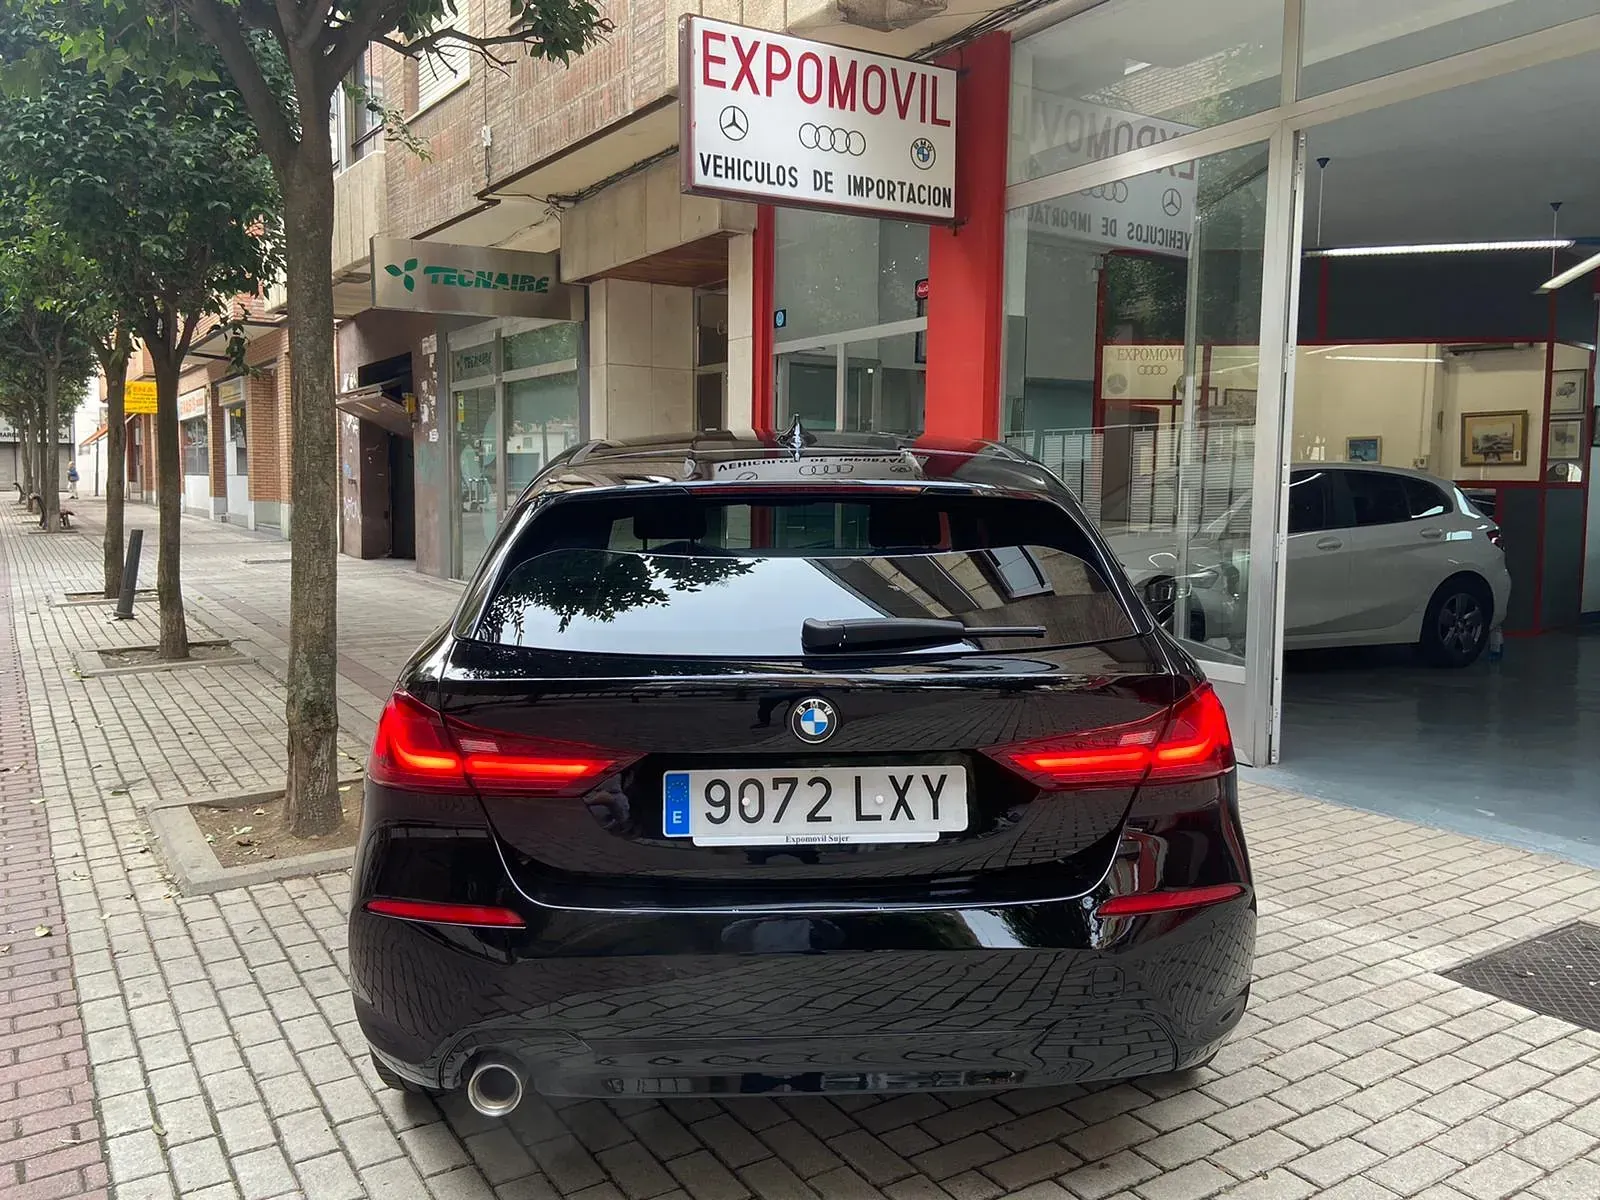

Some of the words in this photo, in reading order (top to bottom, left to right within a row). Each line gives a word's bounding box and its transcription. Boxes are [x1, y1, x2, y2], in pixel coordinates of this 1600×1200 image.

[702, 29, 951, 128] EXPOMOVIL
[700, 152, 798, 188] VEHICULOS
[813, 169, 834, 193] DE
[847, 174, 952, 208] IMPORTACION
[423, 266, 549, 294] TECNAIRE
[1117, 348, 1185, 361] EXPOMOVI
[797, 700, 833, 715] BMW
[672, 811, 682, 824] E
[704, 775, 833, 825] 9072
[854, 774, 948, 821] LXY
[785, 835, 827, 845] Expomovil
[828, 834, 850, 844] Sujer
